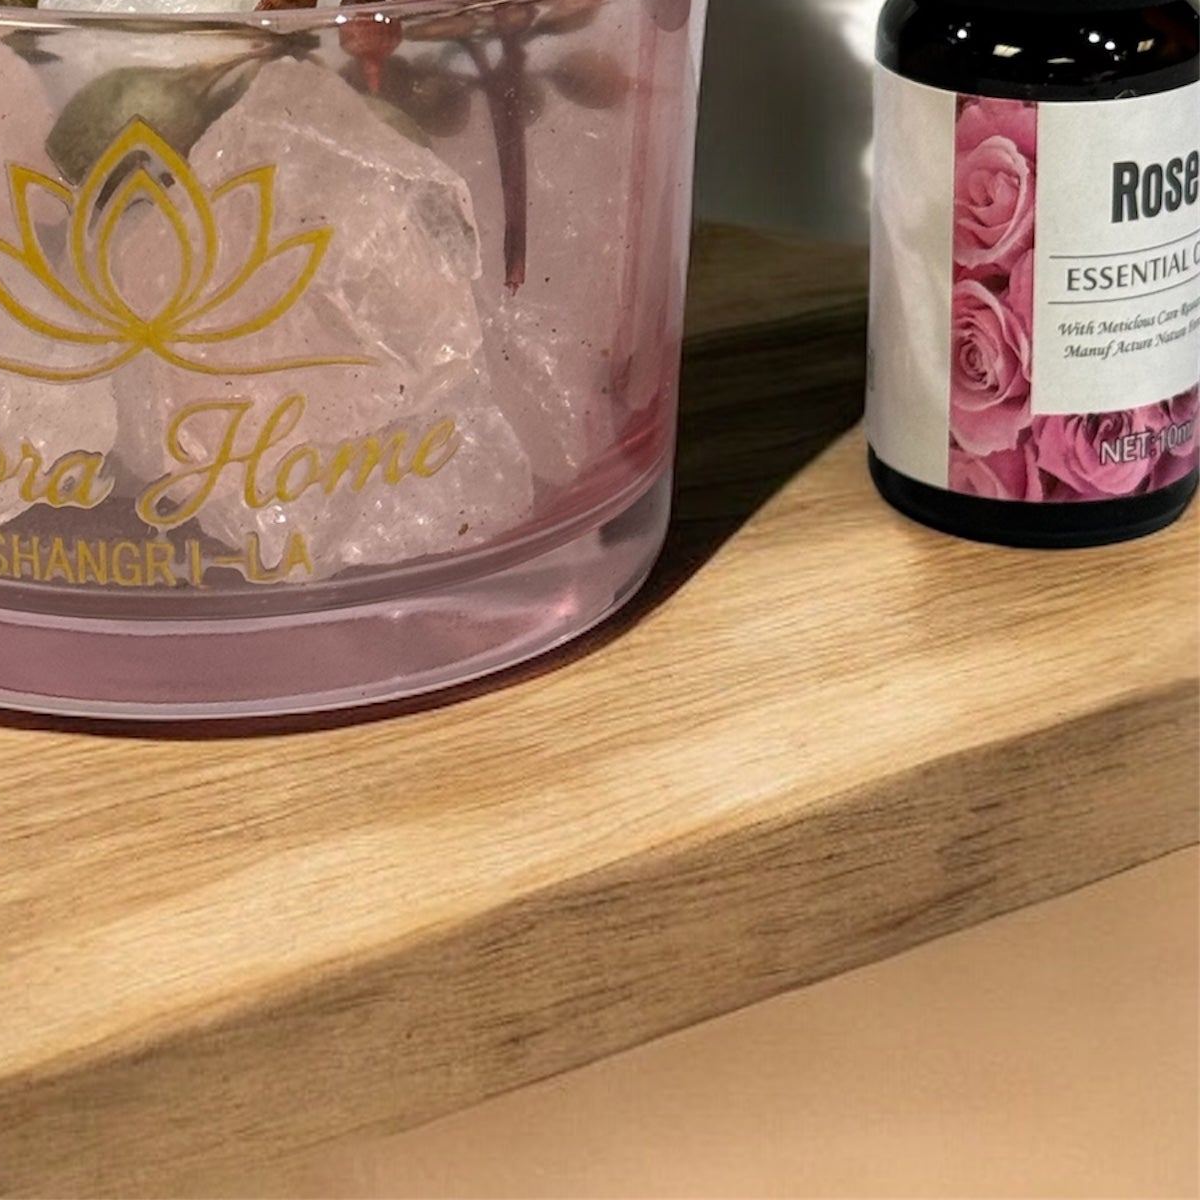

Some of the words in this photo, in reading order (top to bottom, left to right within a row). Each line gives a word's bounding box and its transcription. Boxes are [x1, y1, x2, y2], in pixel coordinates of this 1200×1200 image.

[1111, 150, 1199, 224] Rose
[1066, 249, 1189, 292] ESSENTIAL
[1058, 319, 1094, 336] With
[1063, 339, 1115, 360] Manuf
[136, 393, 459, 525] Home
